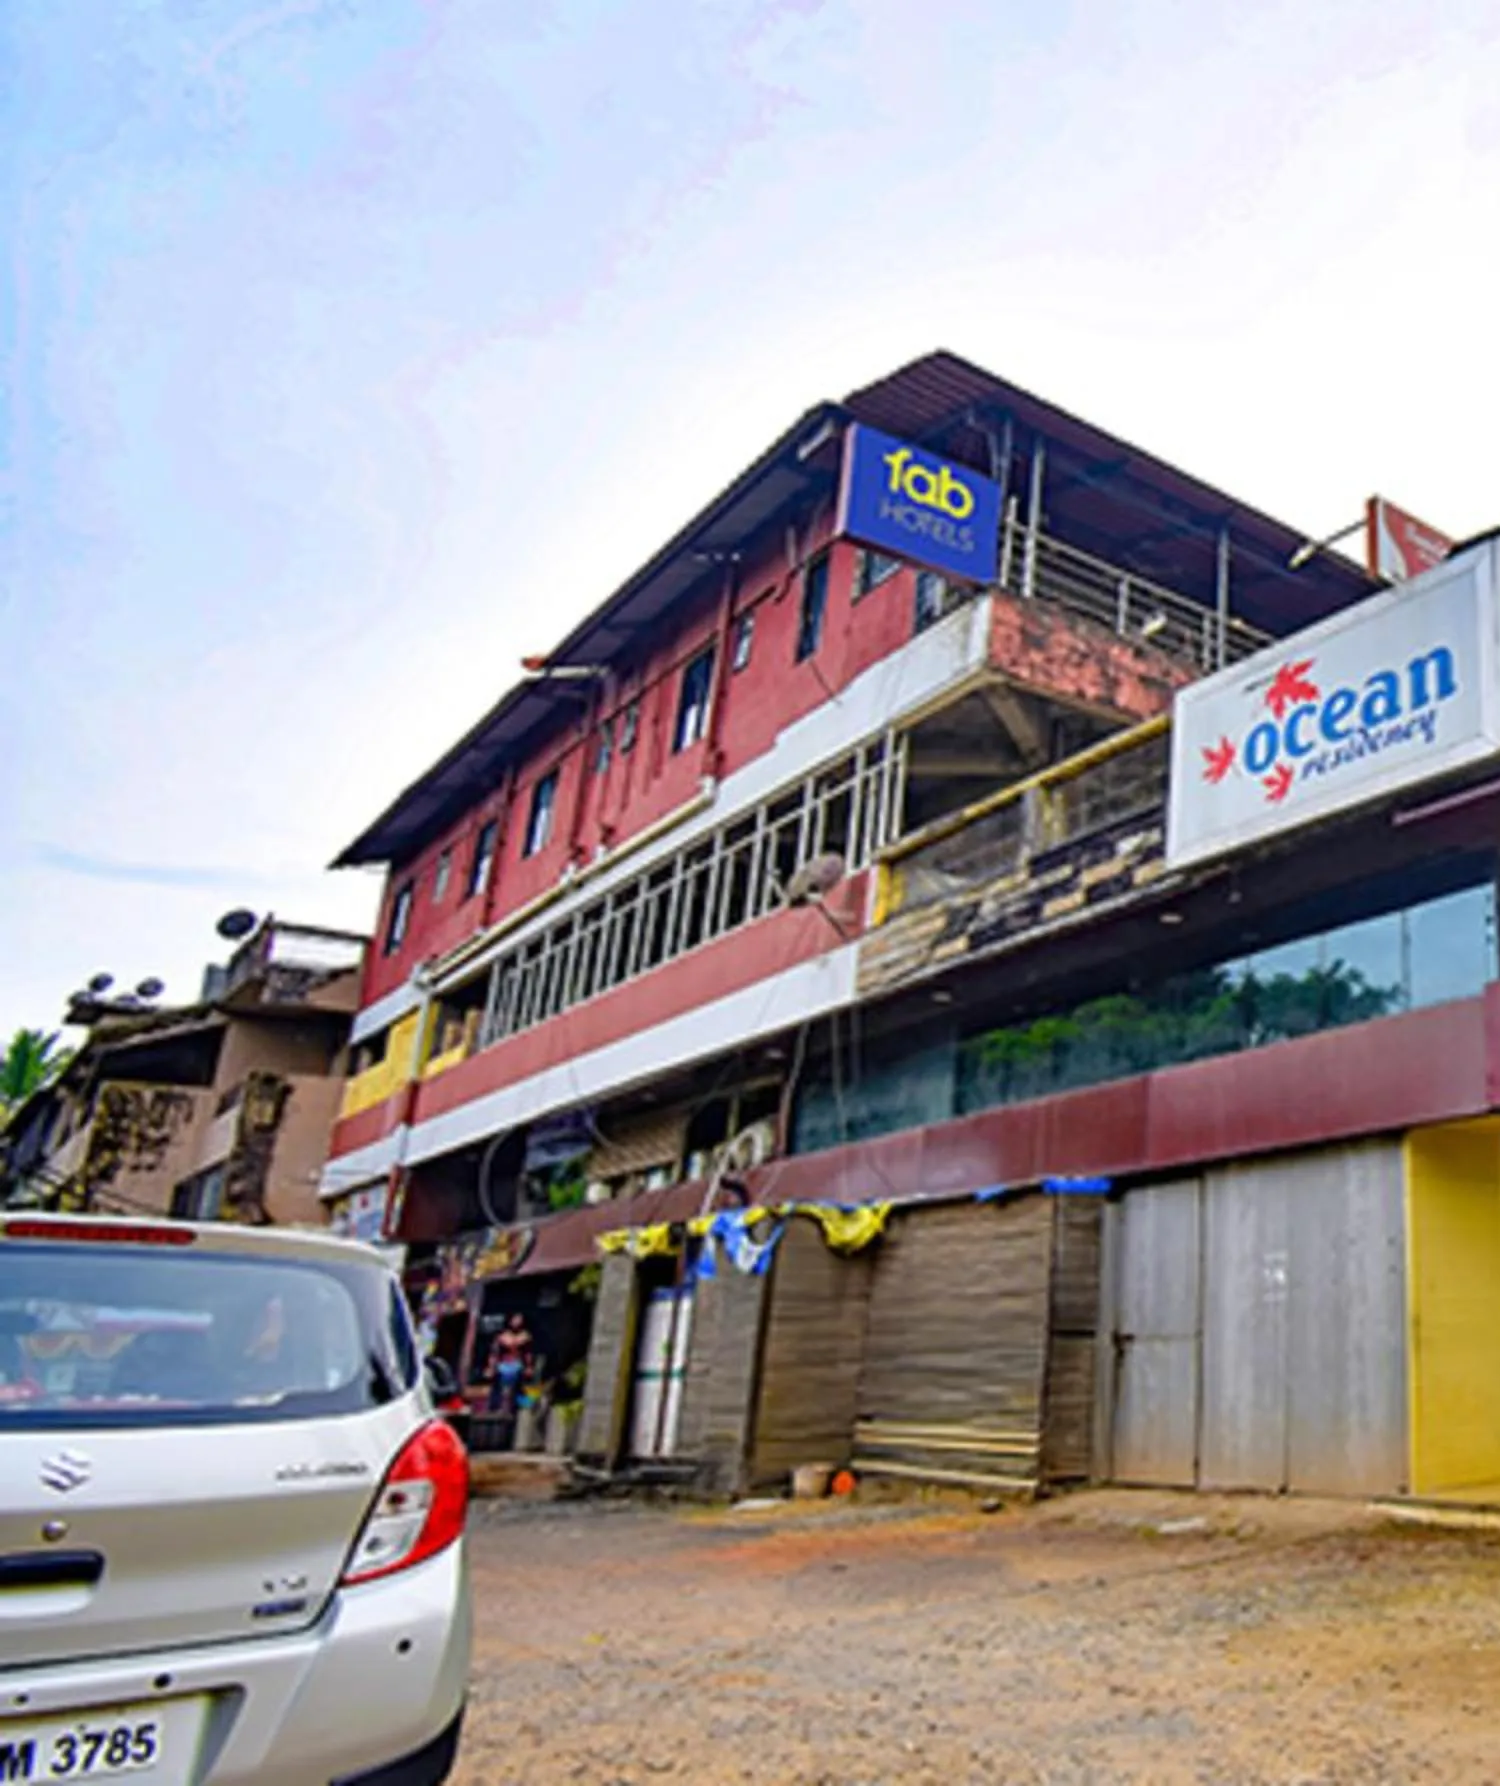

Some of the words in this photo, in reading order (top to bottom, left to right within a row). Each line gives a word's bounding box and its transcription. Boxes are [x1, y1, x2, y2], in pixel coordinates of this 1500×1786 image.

[883, 447, 975, 520] fab
[878, 499, 976, 553] HOTELS
[1243, 646, 1456, 774] ocean
[51, 1722, 157, 1775] 3785
